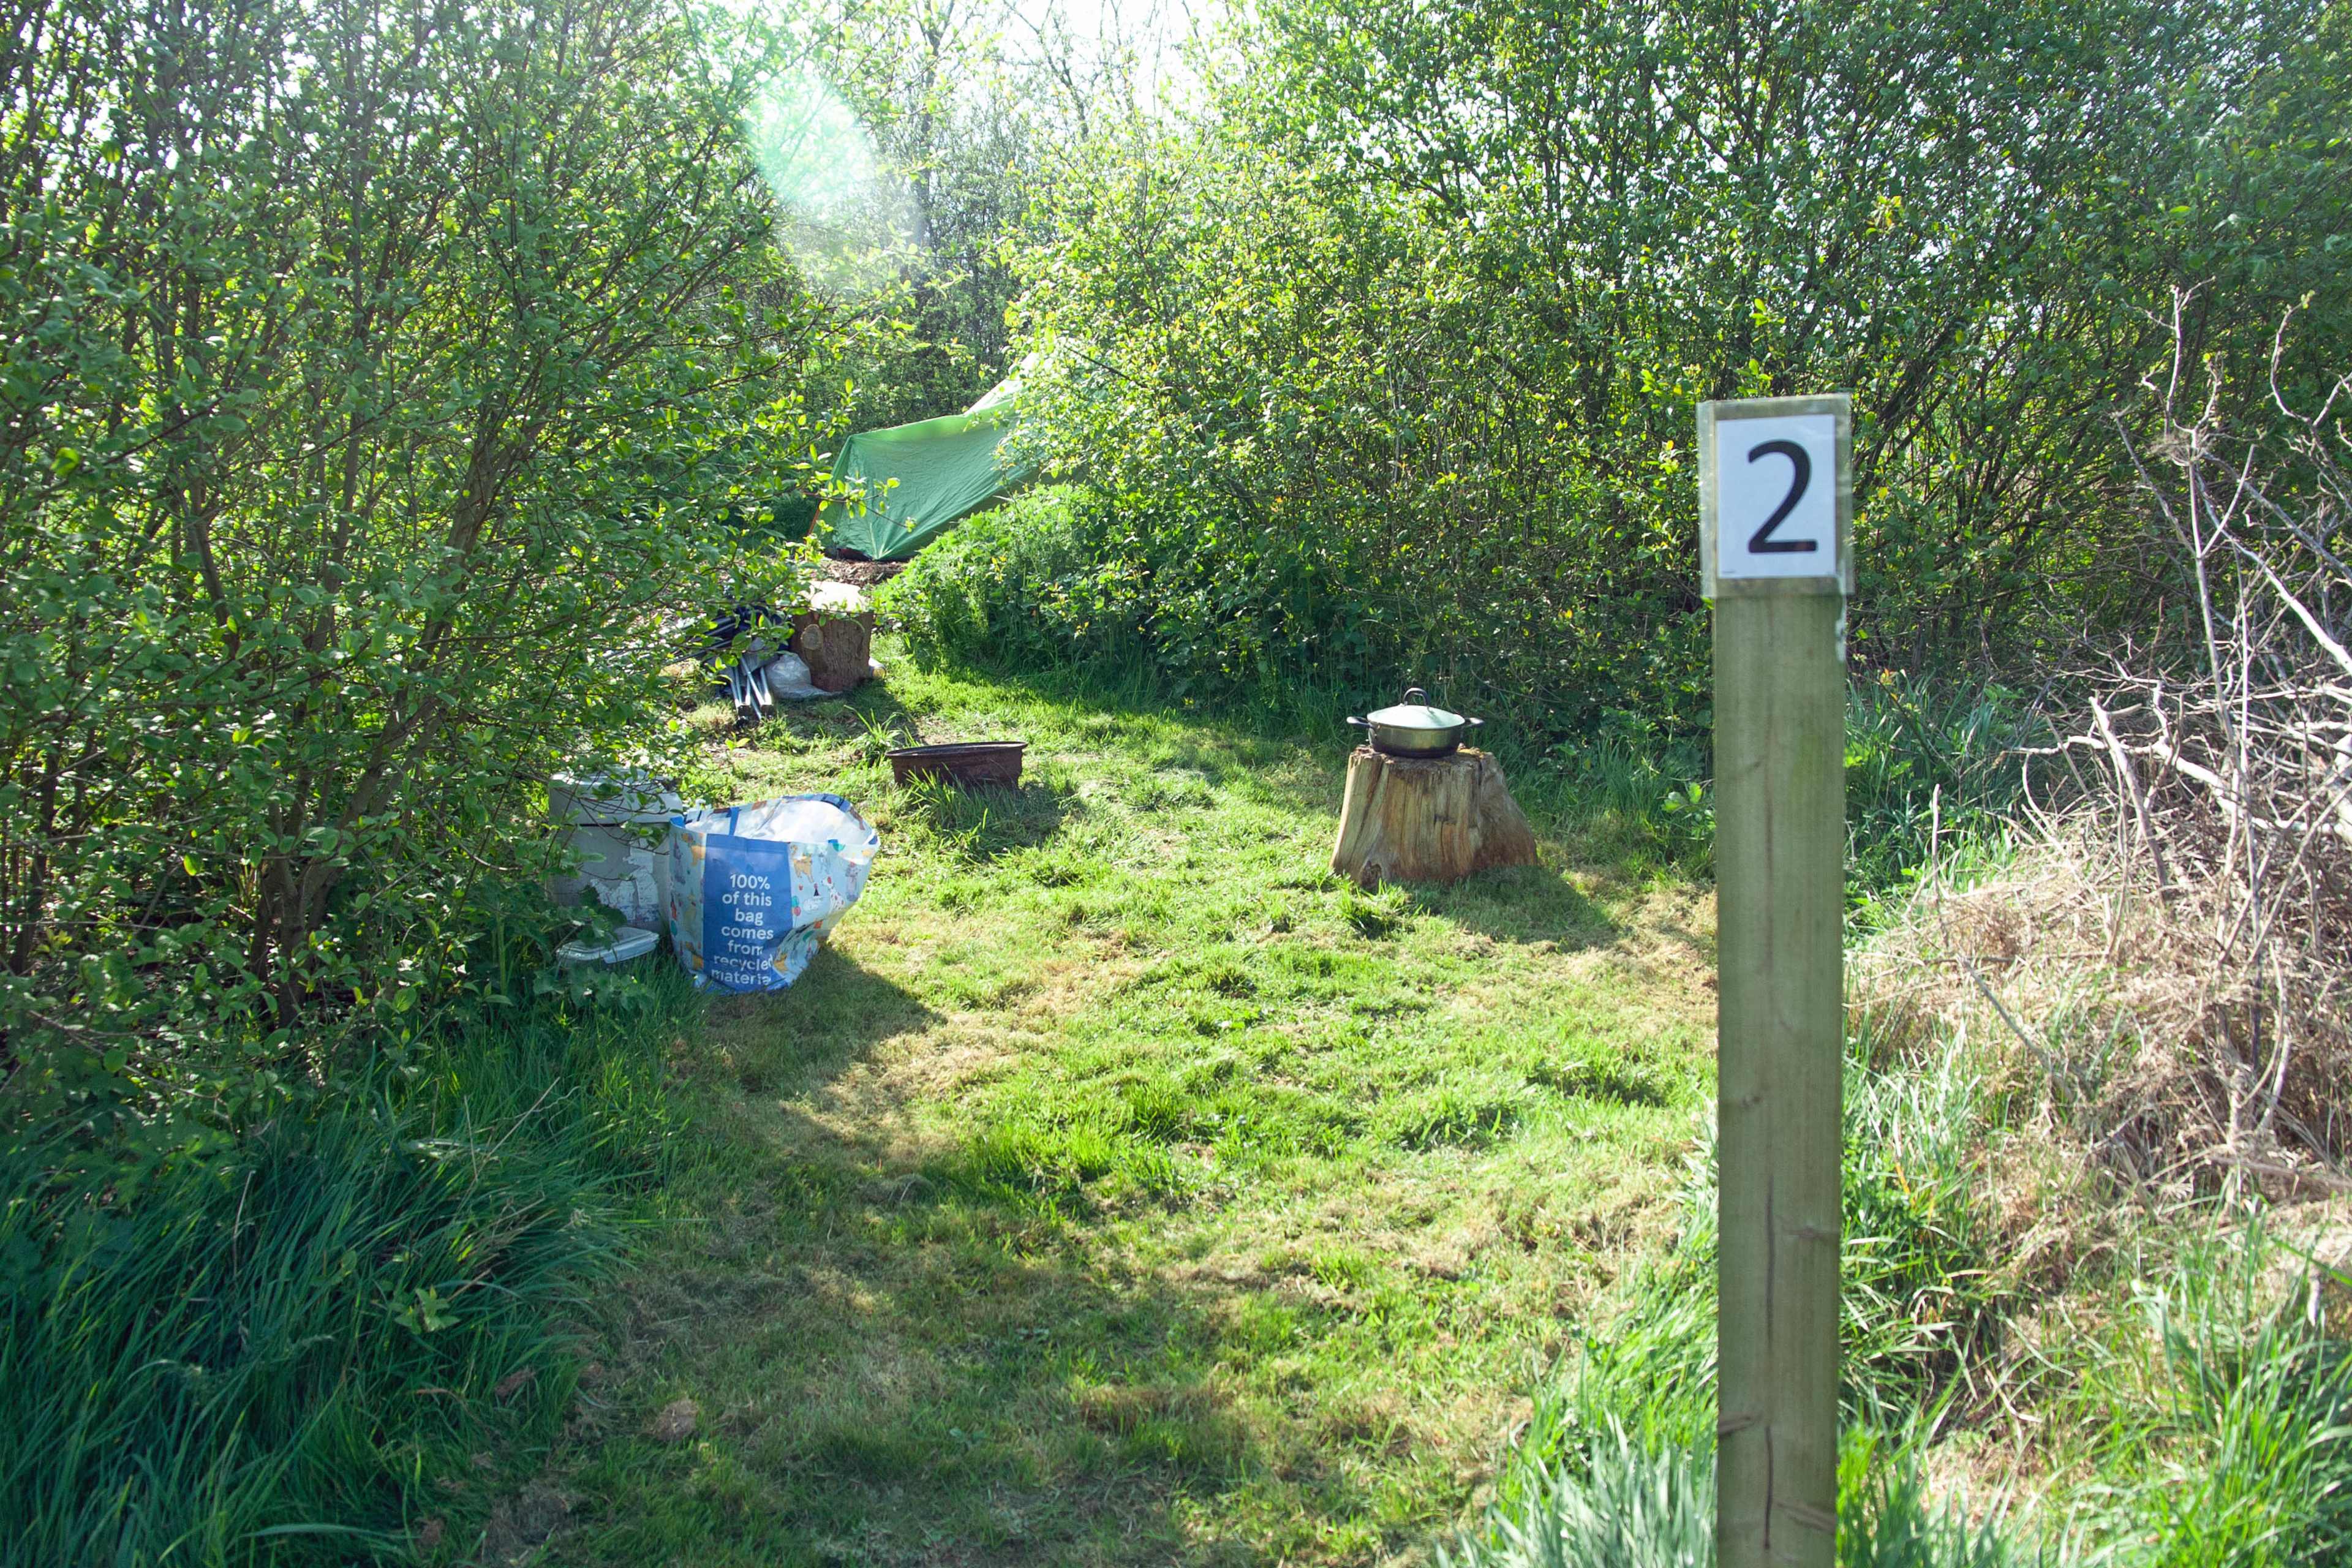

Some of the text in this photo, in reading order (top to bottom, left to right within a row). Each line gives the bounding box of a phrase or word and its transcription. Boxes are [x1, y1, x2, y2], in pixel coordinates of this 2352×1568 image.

[1747, 439, 1817, 553] 2
[730, 874, 770, 889] 100%
[722, 891, 772, 906] of this
[735, 908, 763, 926] bag
[721, 926, 774, 940] comes
[728, 940, 764, 955] from
